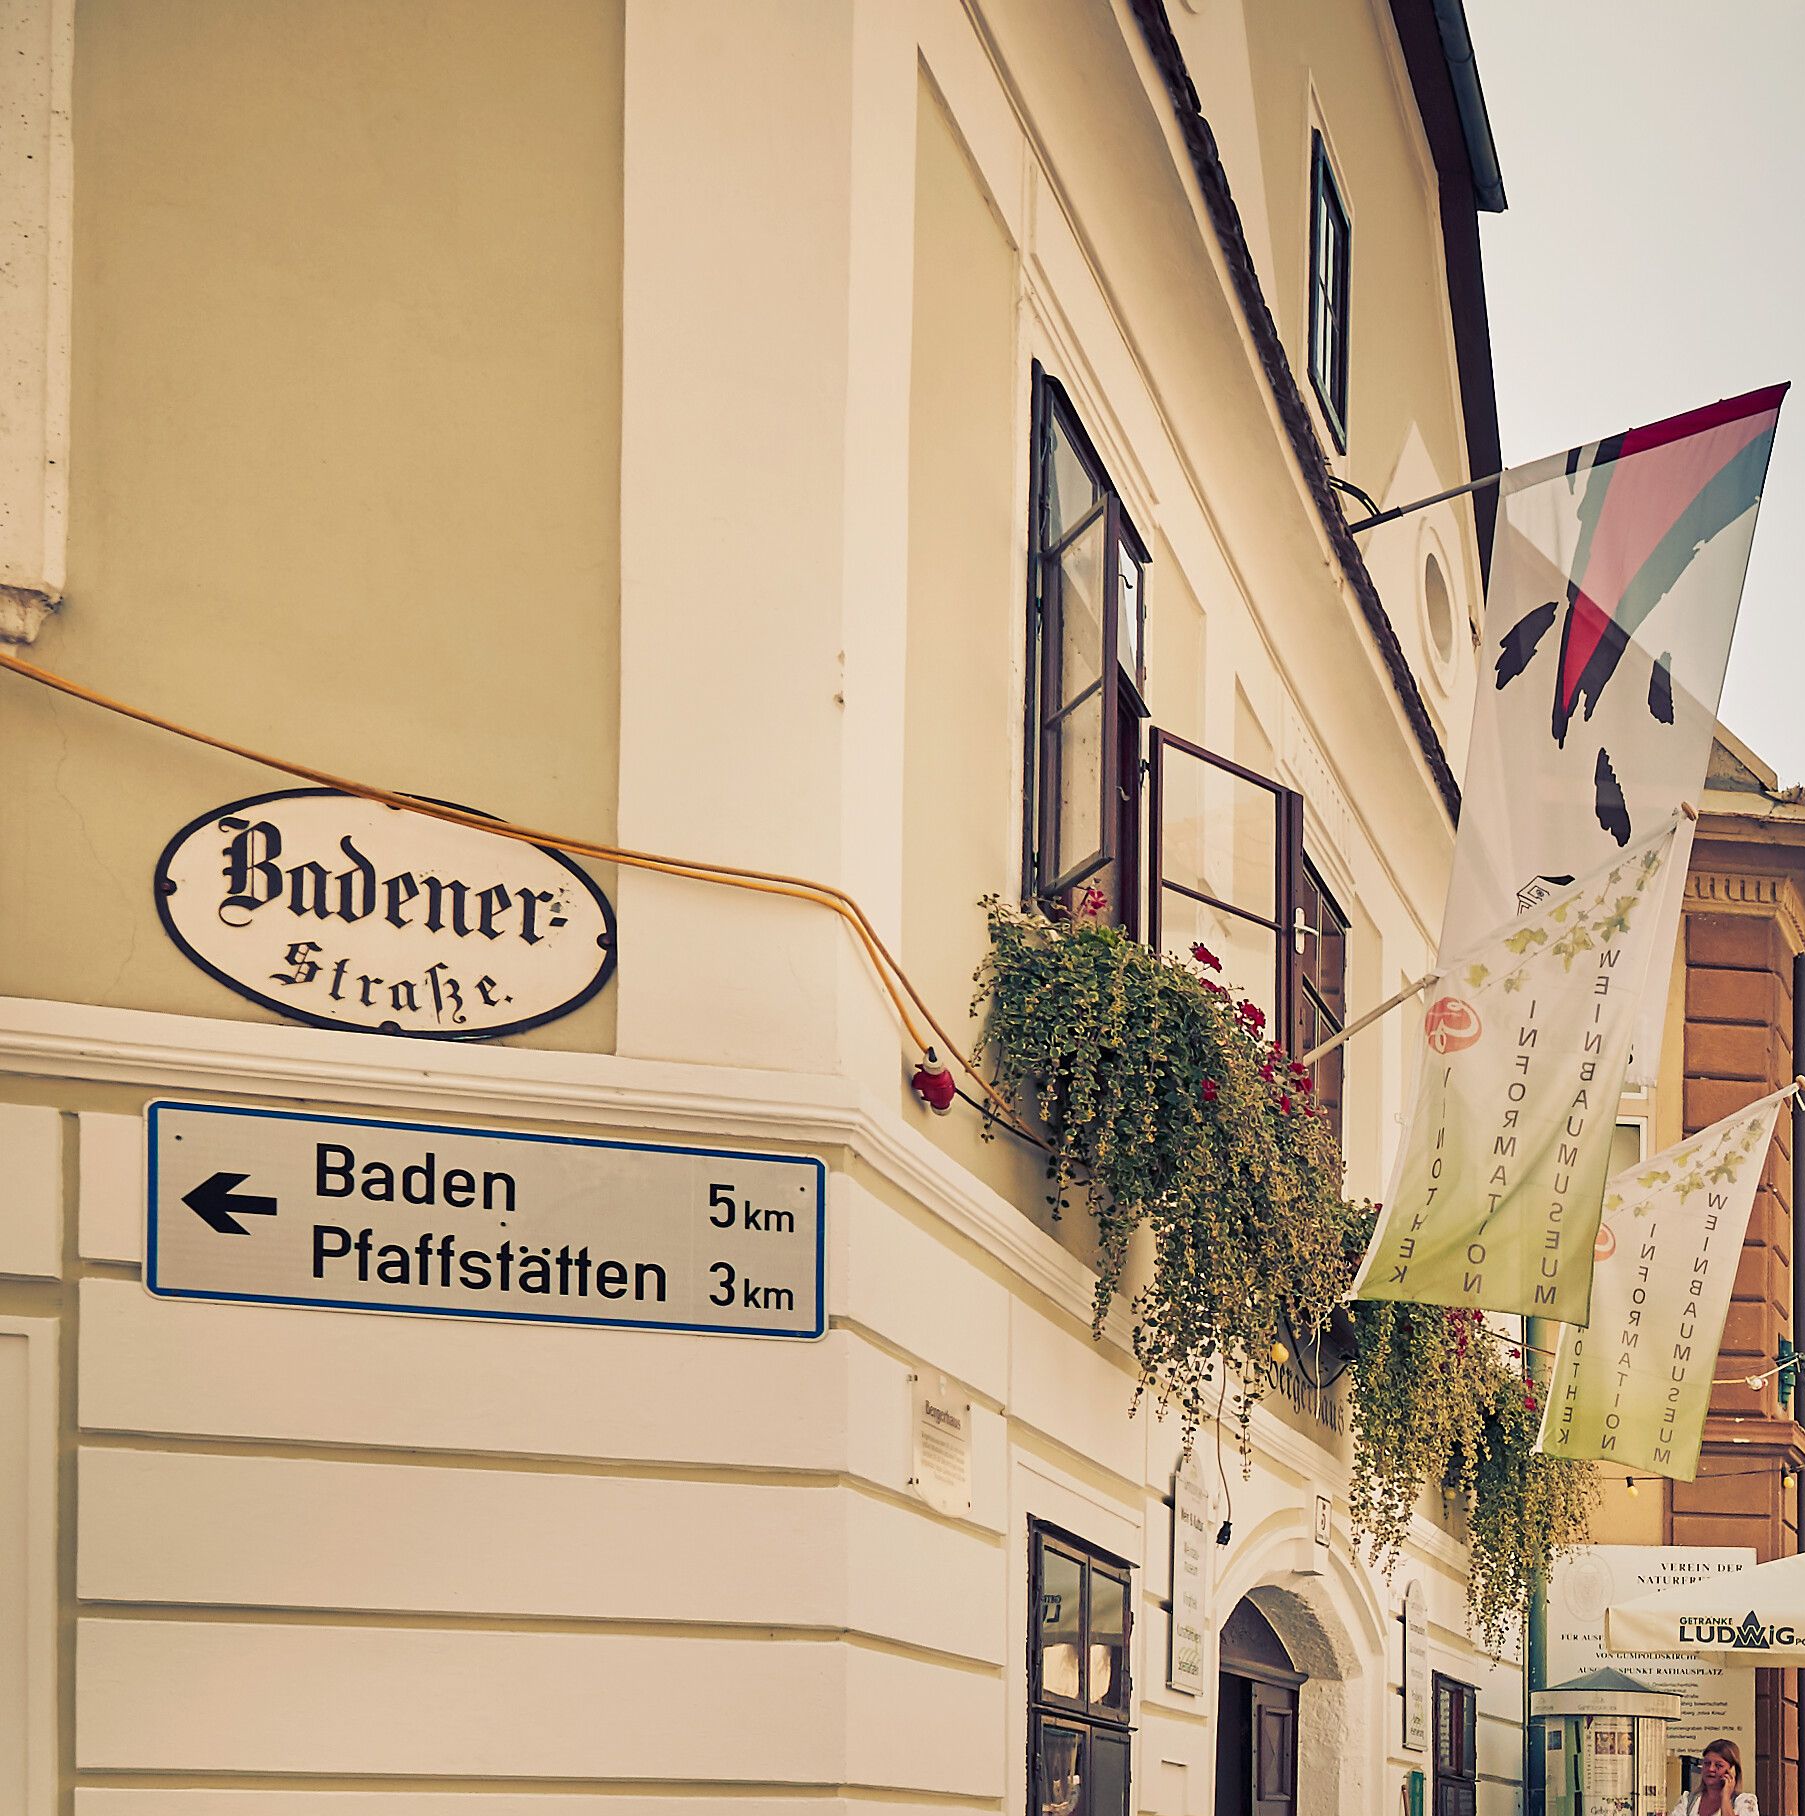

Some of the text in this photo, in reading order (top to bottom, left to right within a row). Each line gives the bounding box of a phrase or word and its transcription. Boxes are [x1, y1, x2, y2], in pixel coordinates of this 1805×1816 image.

[218, 816, 568, 946] Badener-
[316, 1142, 795, 1233] Baden 5 km
[312, 1223, 795, 1311] Pfaffstätten 3 km
[1661, 1563, 1743, 1572] VEREIN DER
[1679, 1616, 1733, 1625] GETRÄNKE
[1596, 1652, 1614, 1661] VON
[1657, 1668, 1724, 1676] RATHAUSPLATZ
